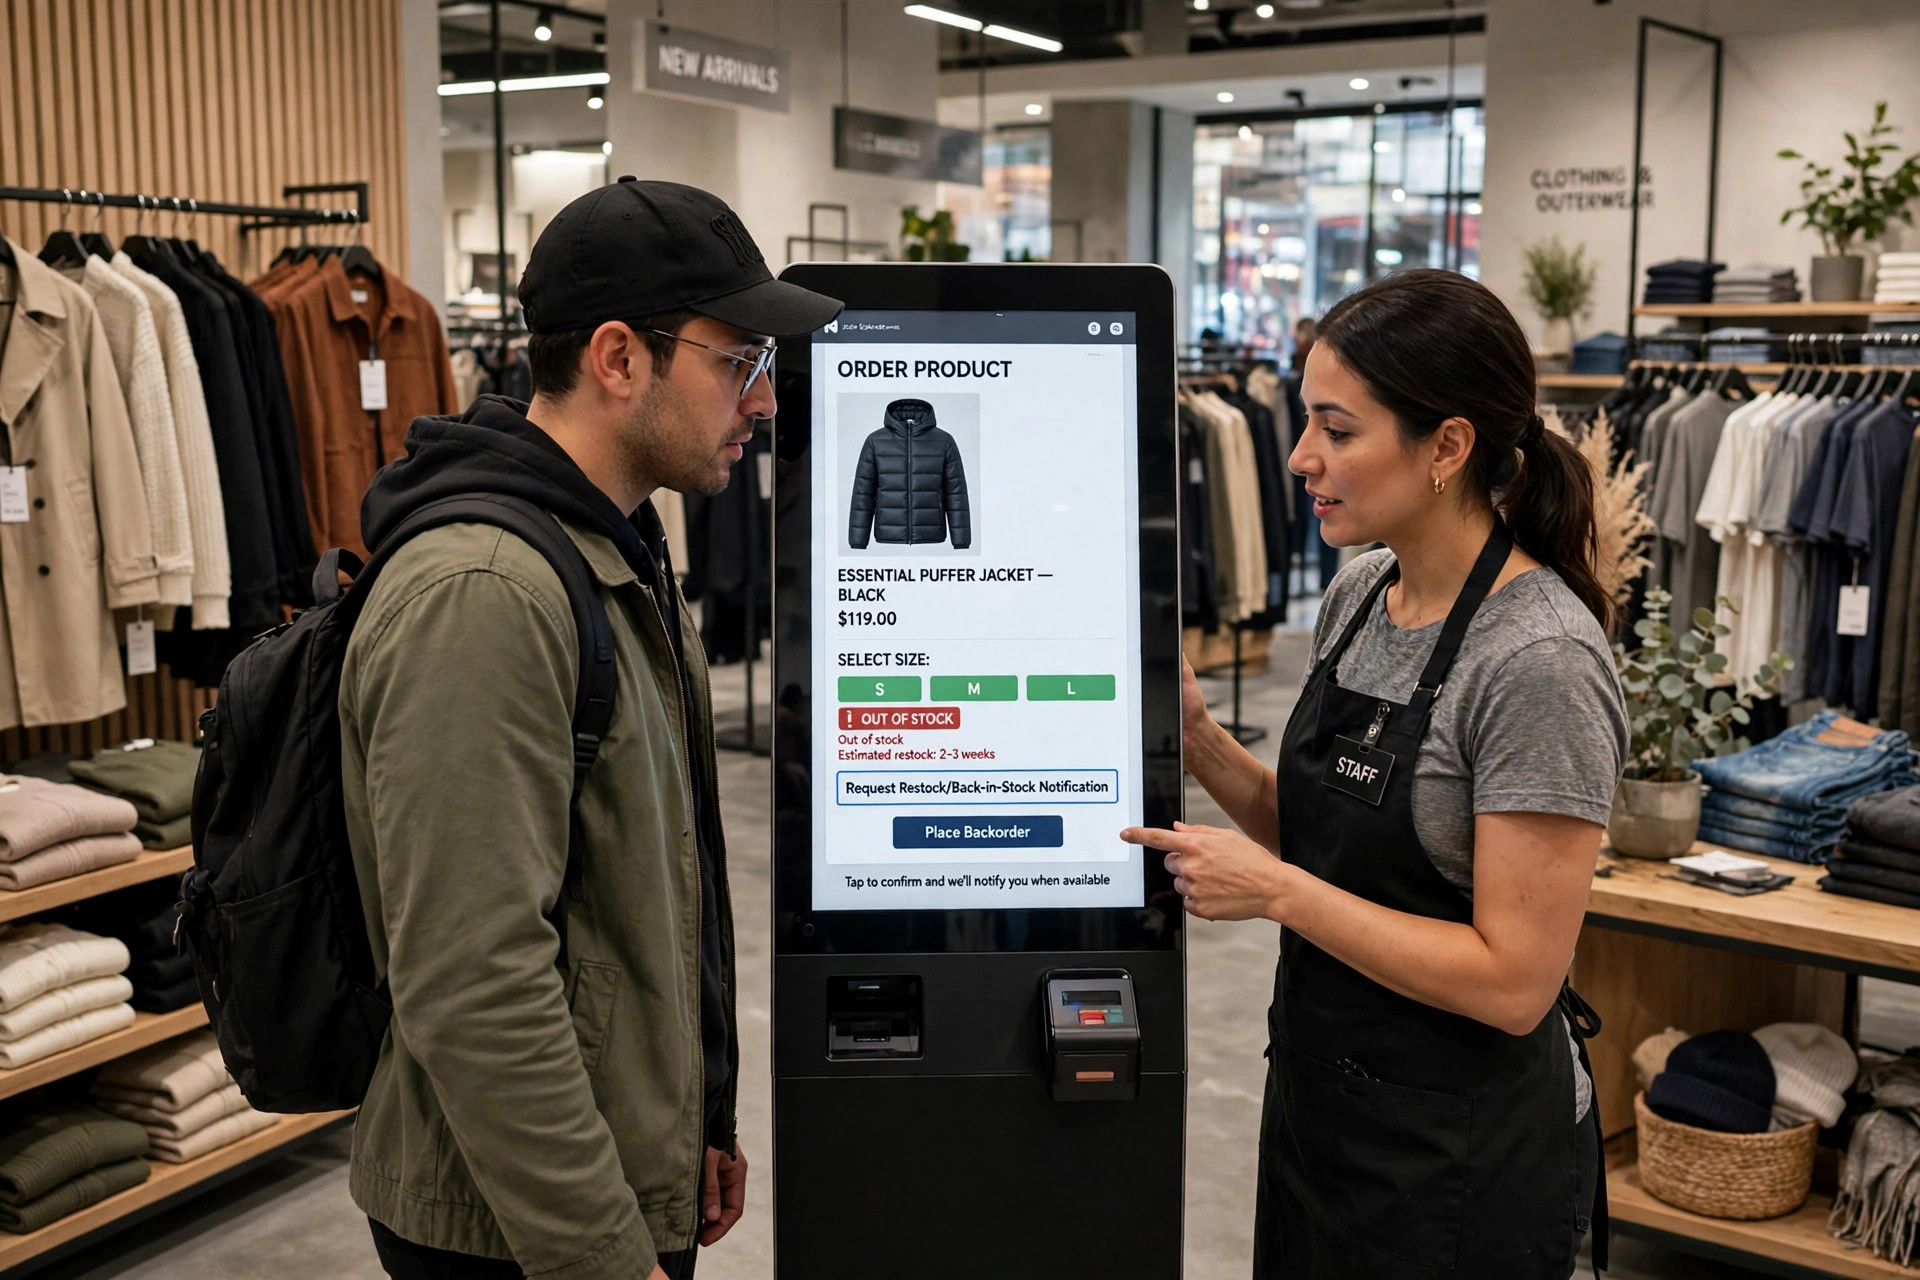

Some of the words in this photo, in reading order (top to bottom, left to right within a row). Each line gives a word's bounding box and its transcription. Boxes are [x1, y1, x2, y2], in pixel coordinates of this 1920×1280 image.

[658, 45, 700, 78] NEW
[702, 54, 779, 94] ARRIVALS
[1530, 167, 1626, 190] CLOTHING
[837, 360, 909, 378] ORDER
[914, 360, 1013, 378] PRODUCT
[838, 568, 916, 582] ESSENTIAL
[920, 568, 976, 582] PUFFER
[978, 567, 1035, 582] JACKET
[838, 588, 886, 602] BLACK
[838, 609, 897, 628] $119.00
[837, 652, 892, 667] SELECT
[894, 652, 930, 667] SIZE:
[875, 682, 885, 697] S
[967, 682, 981, 696] M
[1067, 681, 1076, 695] L
[861, 712, 889, 726] OUT
[891, 712, 909, 726] OF
[911, 712, 954, 726] STOCK
[837, 734, 859, 745] Out
[861, 733, 874, 745] of
[875, 733, 904, 745] stock
[838, 748, 892, 761] Estimated
[894, 748, 937, 761] restock:
[961, 748, 996, 760] weeks
[1336, 756, 1379, 784] STAFF
[845, 781, 896, 798] Request
[899, 780, 1036, 795] Restock/Back-in-Stock
[1039, 779, 1109, 793] Notification
[925, 825, 961, 839] Place
[964, 824, 1031, 839] Backorder
[844, 875, 865, 891] Tap
[866, 877, 879, 888] to
[880, 875, 923, 888] confirm
[924, 874, 945, 887] and
[947, 874, 972, 887] we'll
[974, 874, 1006, 890] notify
[1008, 877, 1029, 890] you
[1030, 874, 1060, 886] when
[1062, 873, 1111, 886] available
